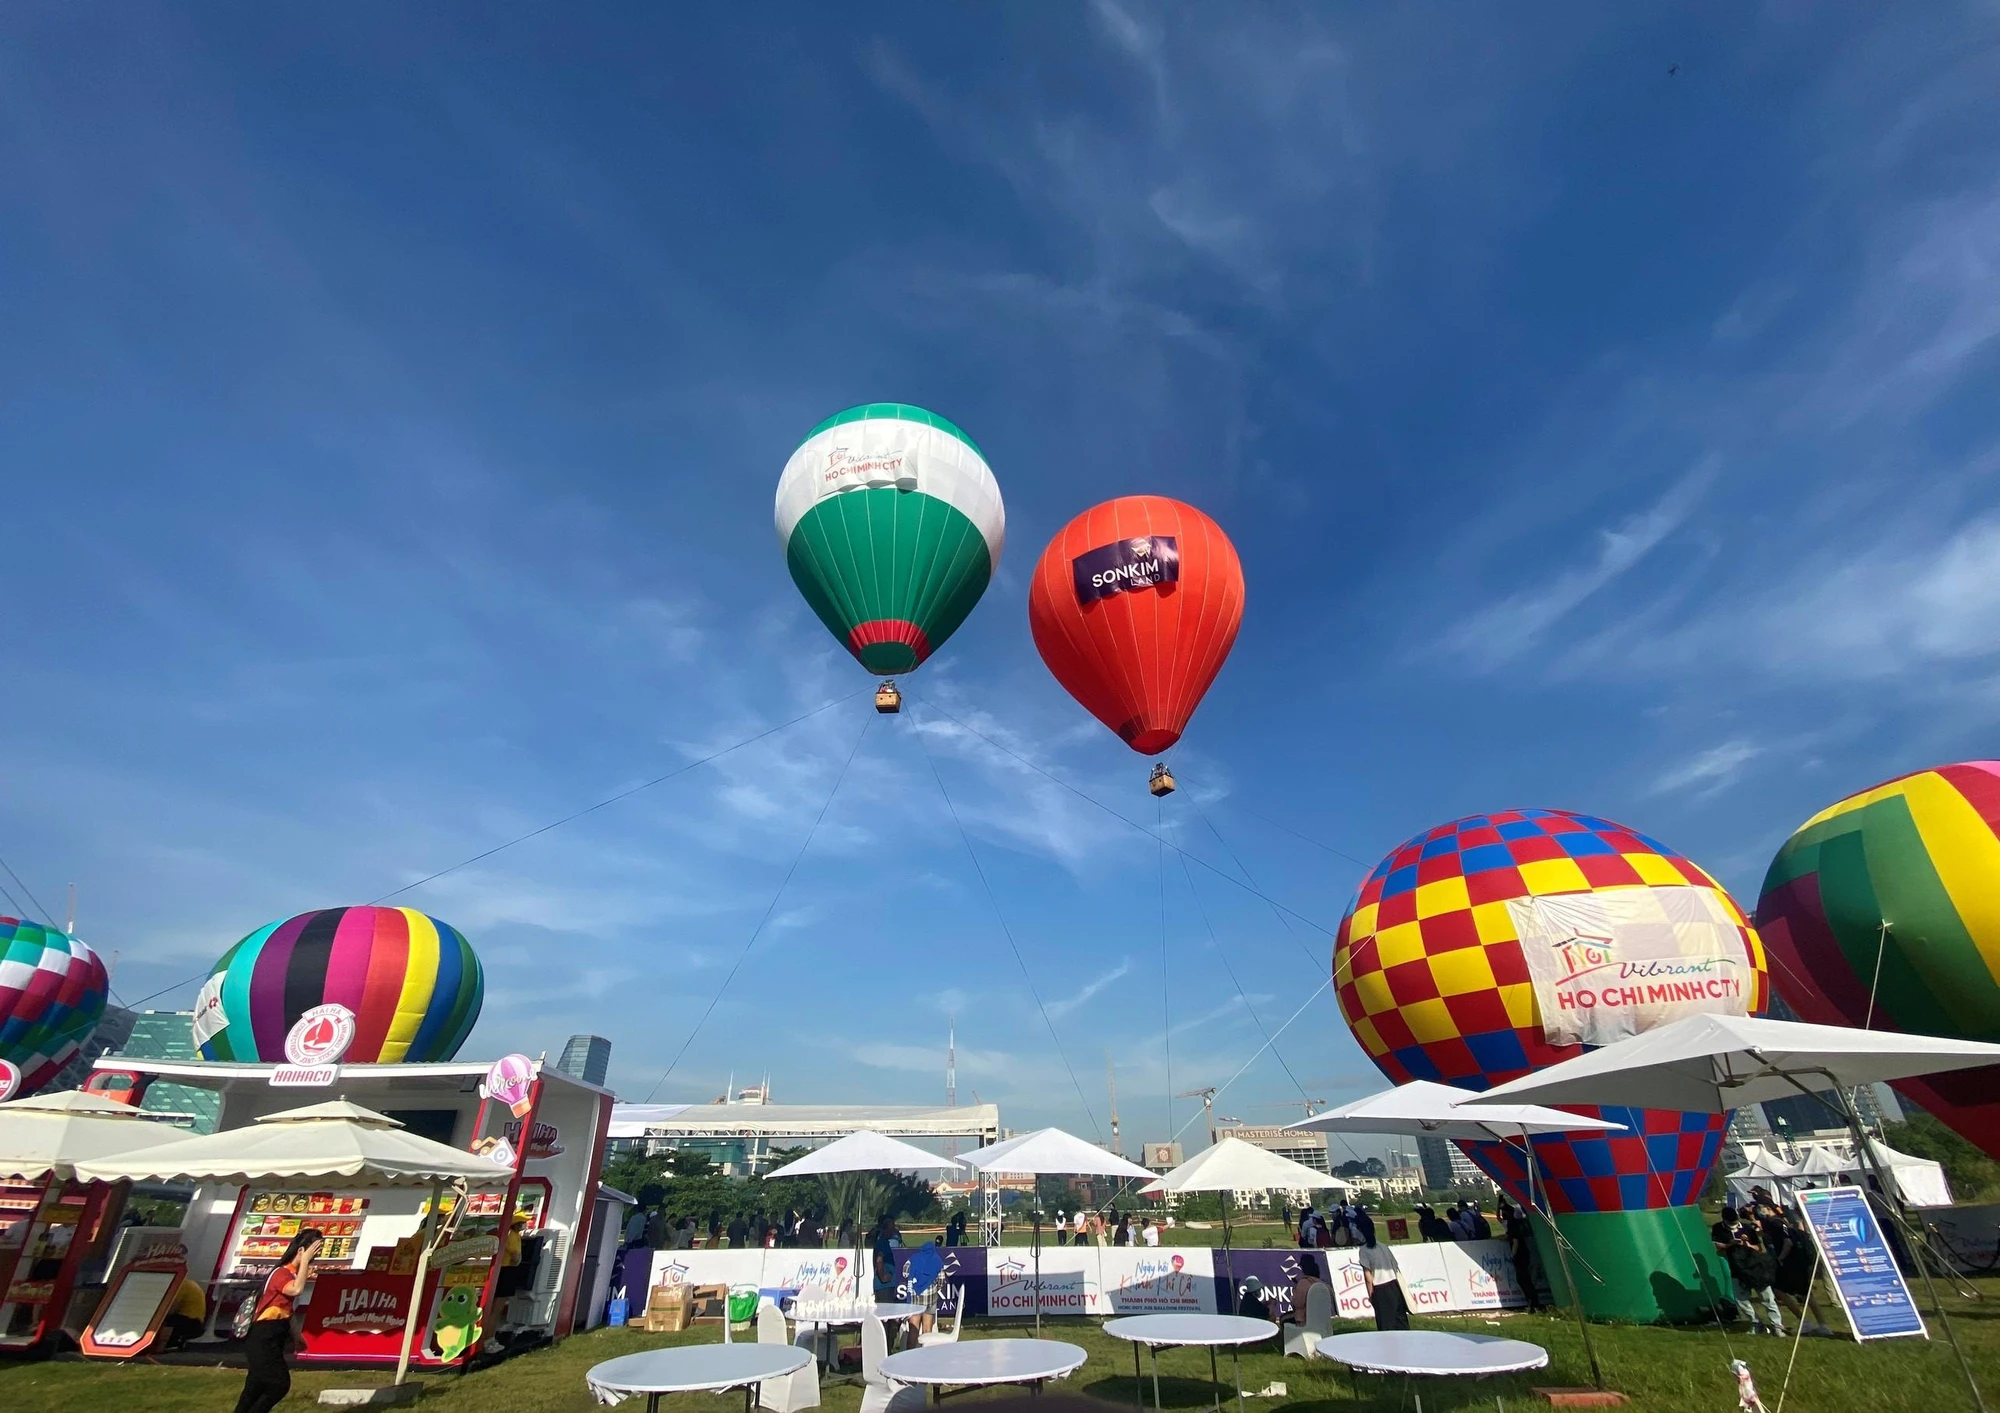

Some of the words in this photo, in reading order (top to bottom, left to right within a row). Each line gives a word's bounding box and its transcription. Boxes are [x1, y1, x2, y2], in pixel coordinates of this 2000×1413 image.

[1092, 559, 1159, 588] SONKIM
[1130, 574, 1160, 587] LAND
[1620, 959, 1736, 979] Vibrant
[1558, 990, 1597, 1010] HO
[1601, 984, 1645, 1007] CHI
[1647, 978, 1706, 1002] MINH
[273, 1070, 332, 1082] HAIHACO
[1237, 1130, 1283, 1138] MASTERISE
[992, 1296, 1010, 1308] HO
[1013, 1296, 1033, 1308] CHI
[1037, 1296, 1066, 1307] MINH
[1068, 1294, 1097, 1306] CITY
[1341, 1299, 1360, 1310] HO
[1418, 1291, 1448, 1304] CITY
